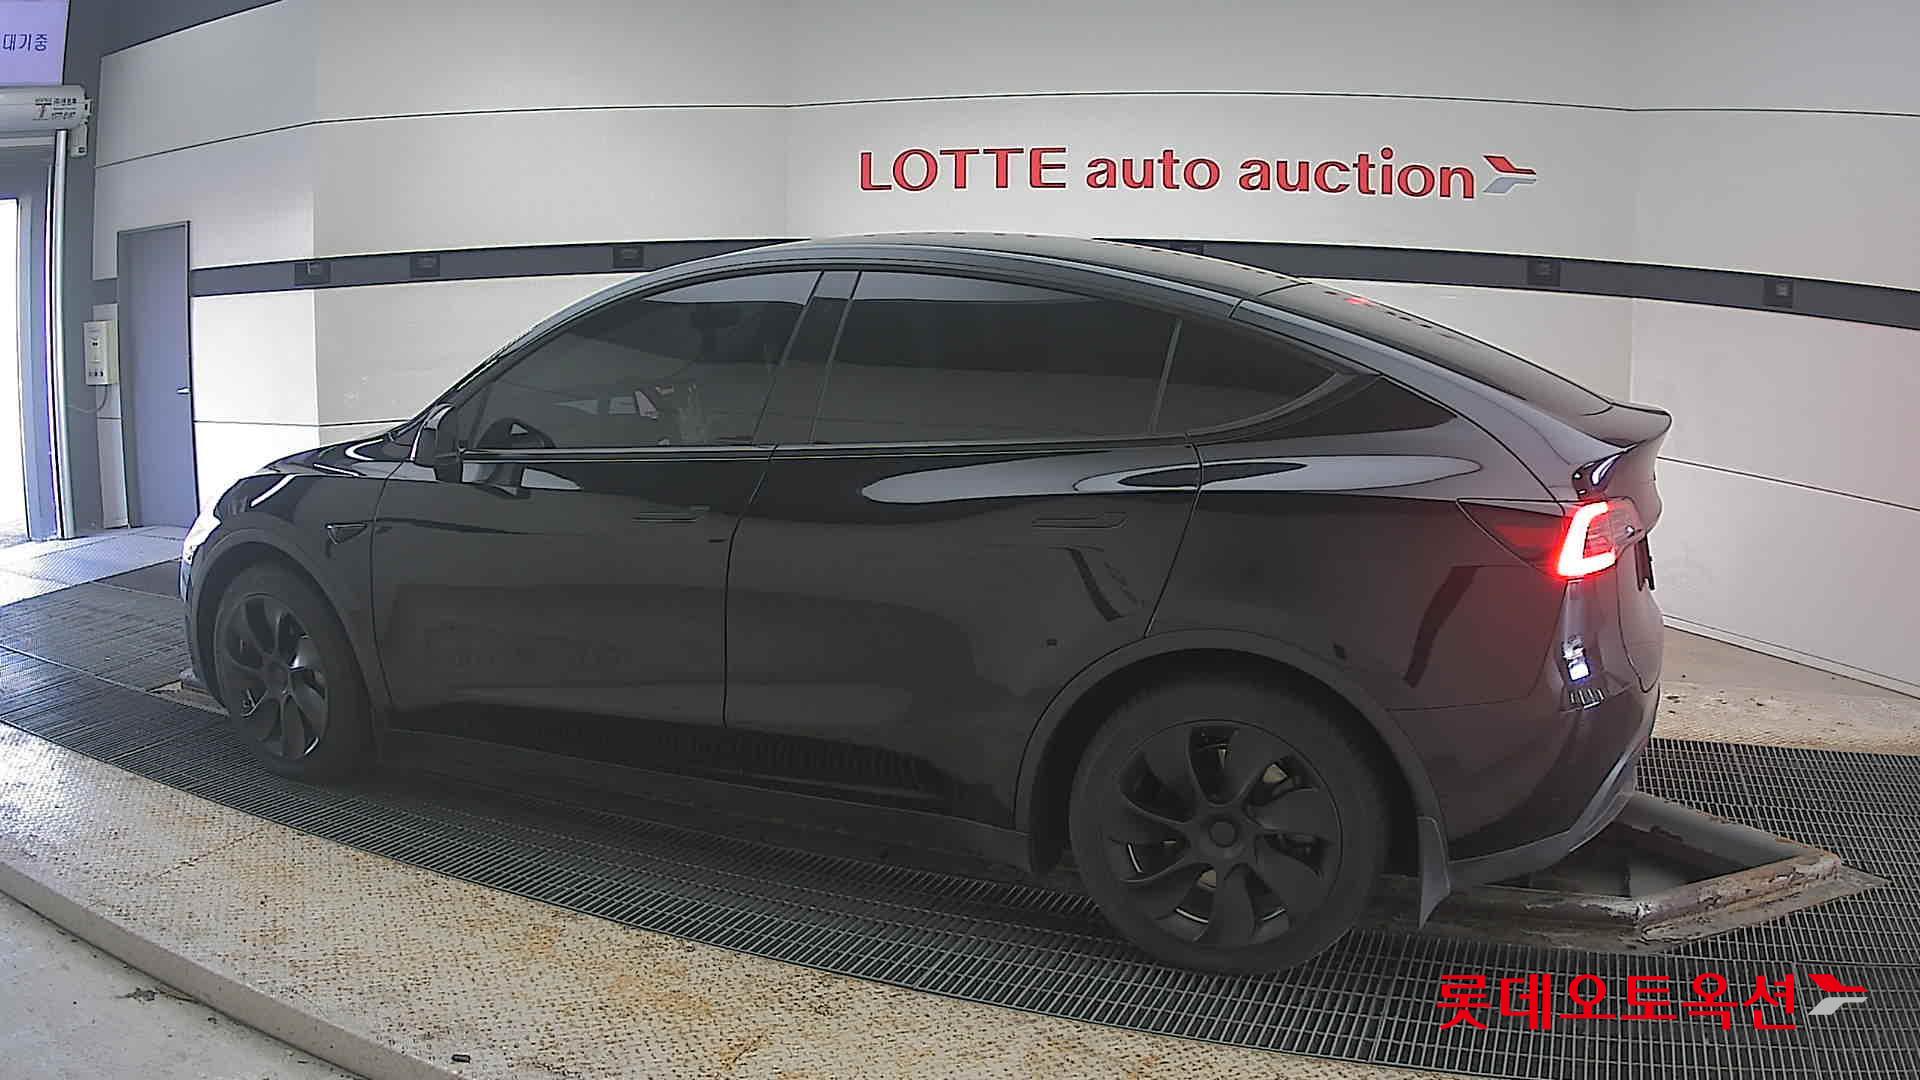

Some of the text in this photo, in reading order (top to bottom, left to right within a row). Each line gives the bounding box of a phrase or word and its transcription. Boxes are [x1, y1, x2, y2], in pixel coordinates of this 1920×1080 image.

[2, 33, 48, 52] 대기중
[859, 147, 1476, 198] LOTTE auto auction
